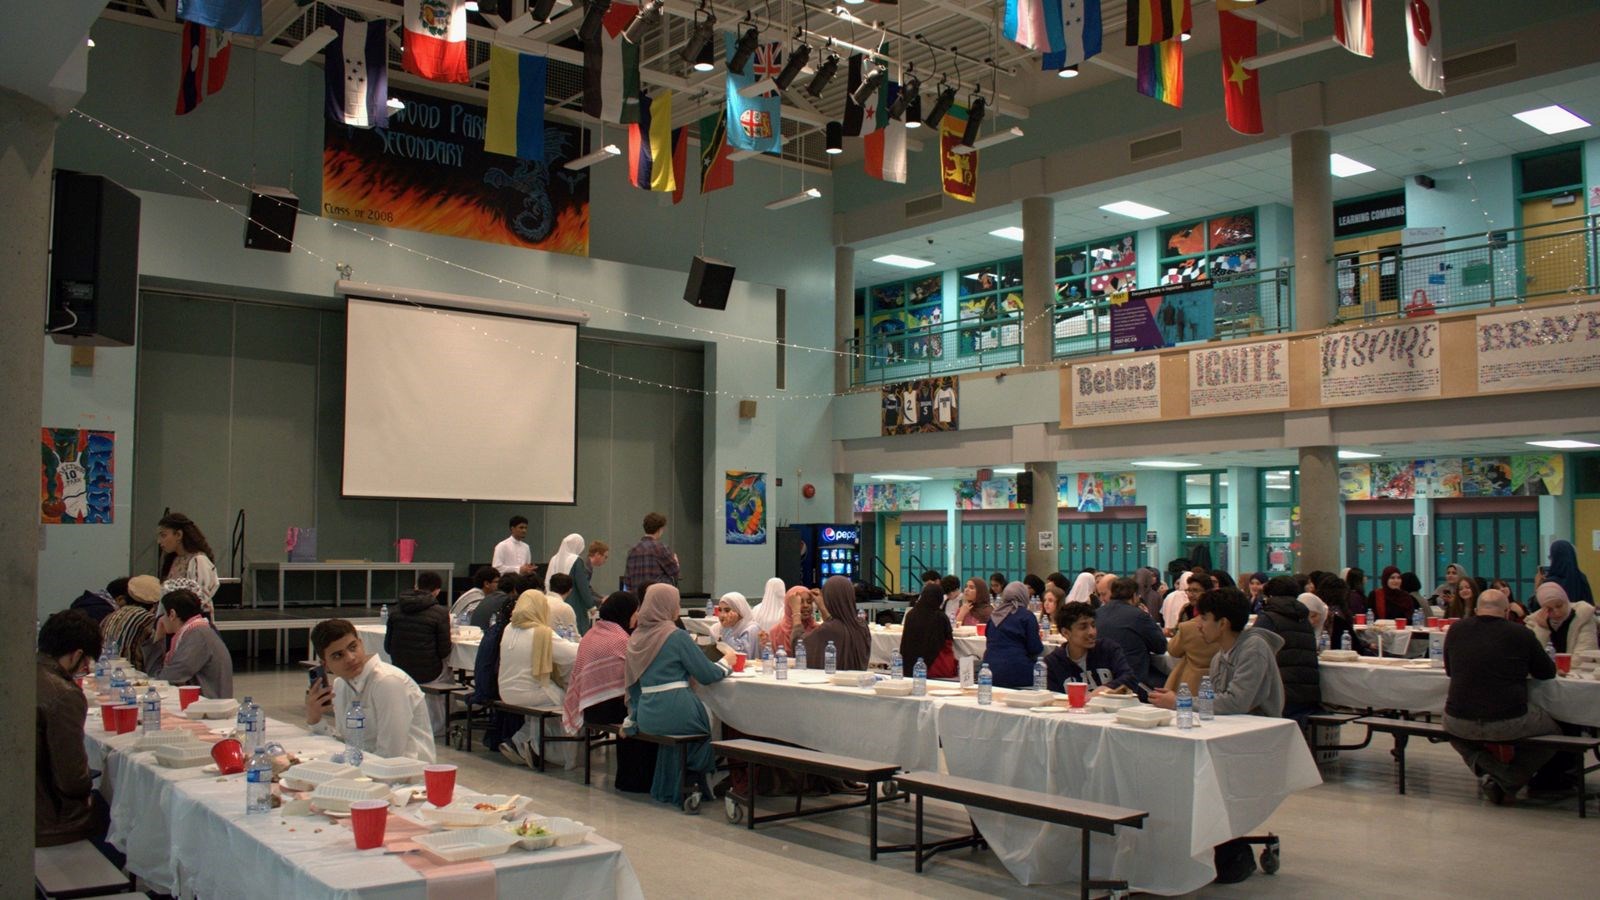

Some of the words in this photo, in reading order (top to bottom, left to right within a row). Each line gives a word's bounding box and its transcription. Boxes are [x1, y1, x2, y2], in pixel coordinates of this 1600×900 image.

[374, 127, 464, 167] SECONDARY
[367, 209, 394, 222] 2008
[1339, 212, 1370, 226] LEARNING
[1370, 206, 1405, 221] COMMONS
[1322, 324, 1437, 375] INSPIRE
[1196, 343, 1284, 387] IGNITE
[65, 469, 77, 480] 10
